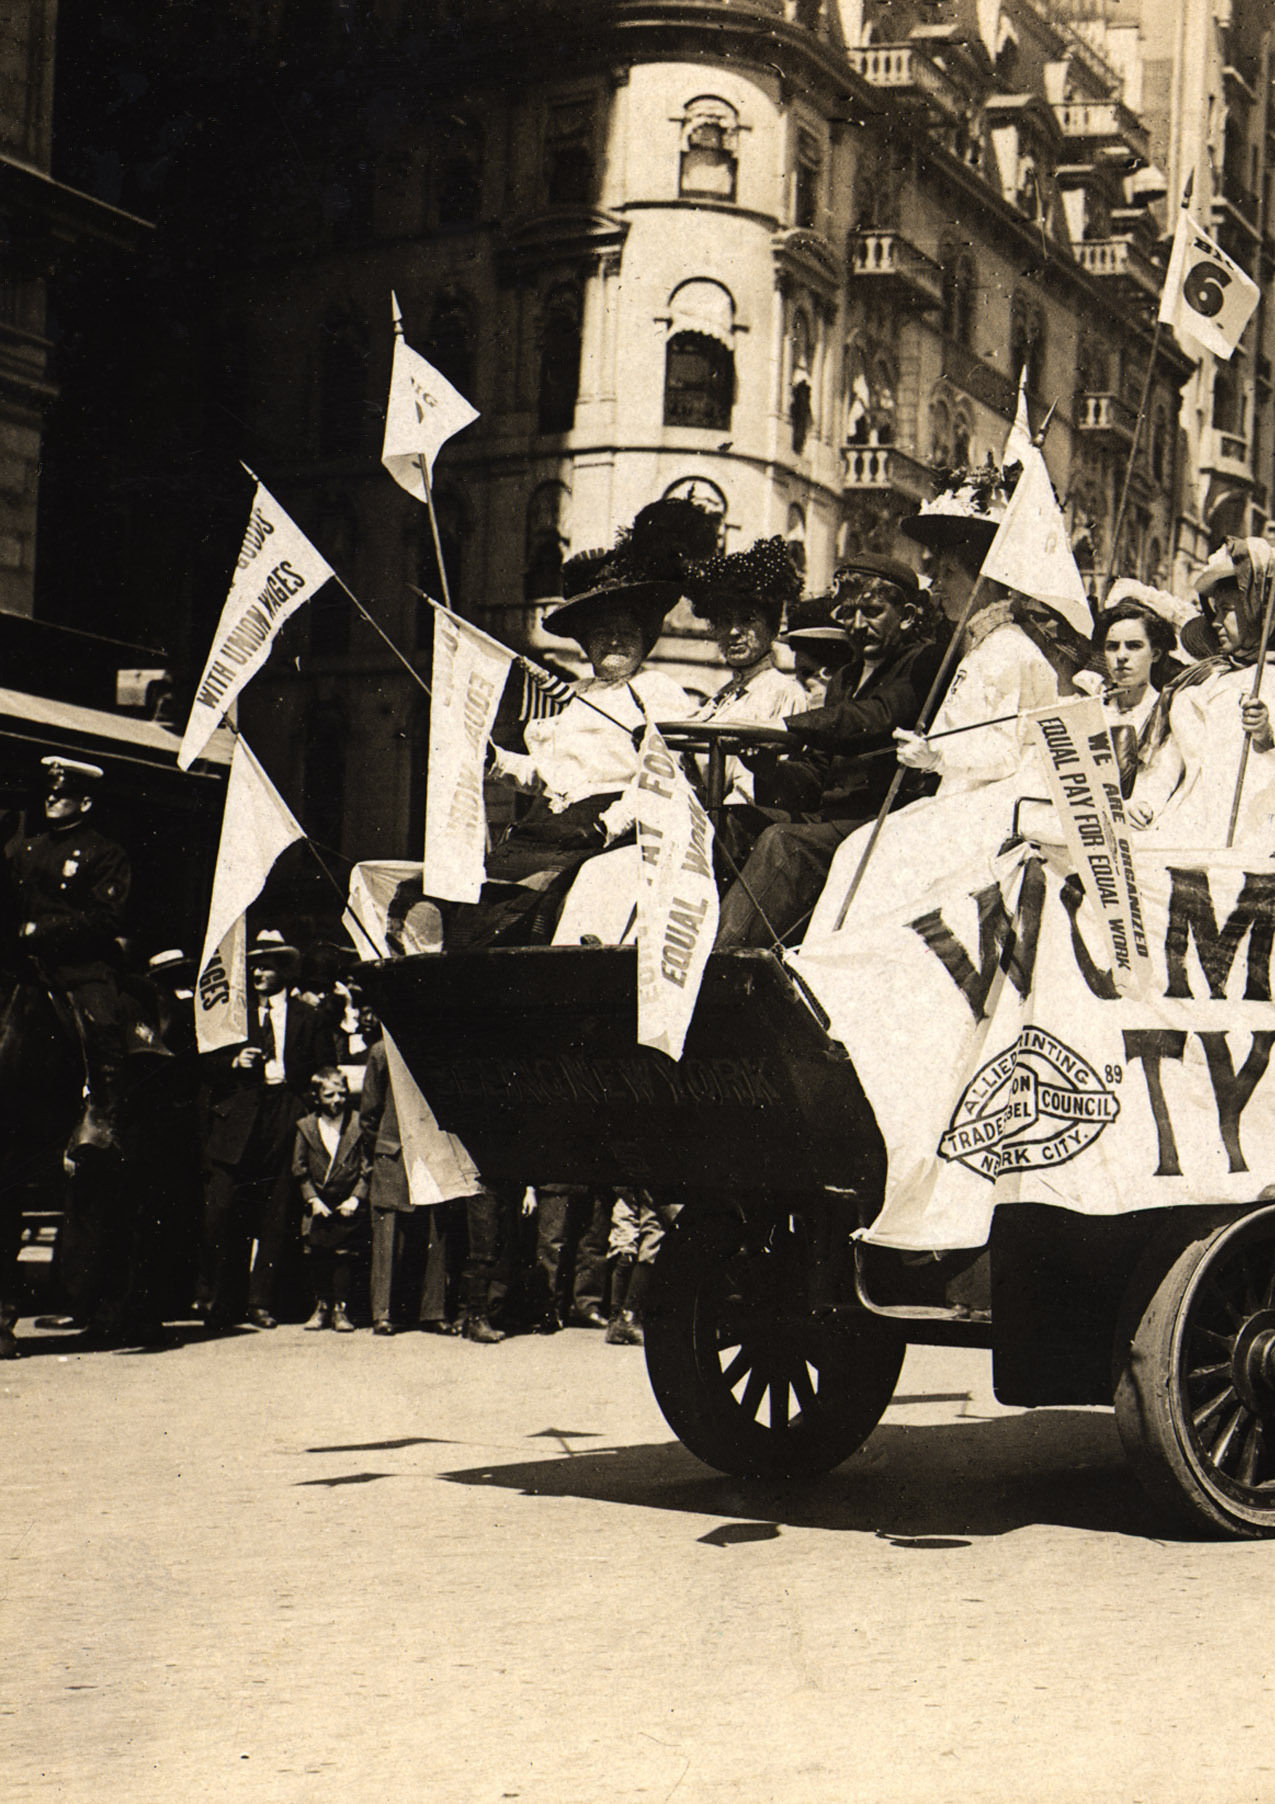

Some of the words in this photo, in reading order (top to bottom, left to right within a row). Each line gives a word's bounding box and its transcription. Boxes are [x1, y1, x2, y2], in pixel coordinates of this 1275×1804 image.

[1183, 261, 1233, 318] 6
[197, 661, 237, 710] WITH
[221, 605, 272, 666] UNION
[257, 560, 306, 621] WAGES
[1036, 716, 1080, 771] EQUAL
[1059, 772, 1095, 808] PAY
[1074, 813, 1106, 848] FOR
[1088, 731, 1113, 766] WE
[1102, 782, 1127, 825] ARE
[1118, 838, 1149, 958] ORGANIZED
[1087, 855, 1120, 909] EQUAL
[661, 896, 709, 989] EQUAL
[1108, 918, 1132, 971] WORK
[1018, 1032, 1089, 1085] INTING
[1104, 1065, 1124, 1084] 89
[948, 1116, 1004, 1152] TRADE
[1041, 1089, 1112, 1116] COUNCIL
[1042, 1129, 1090, 1161] CITY.
